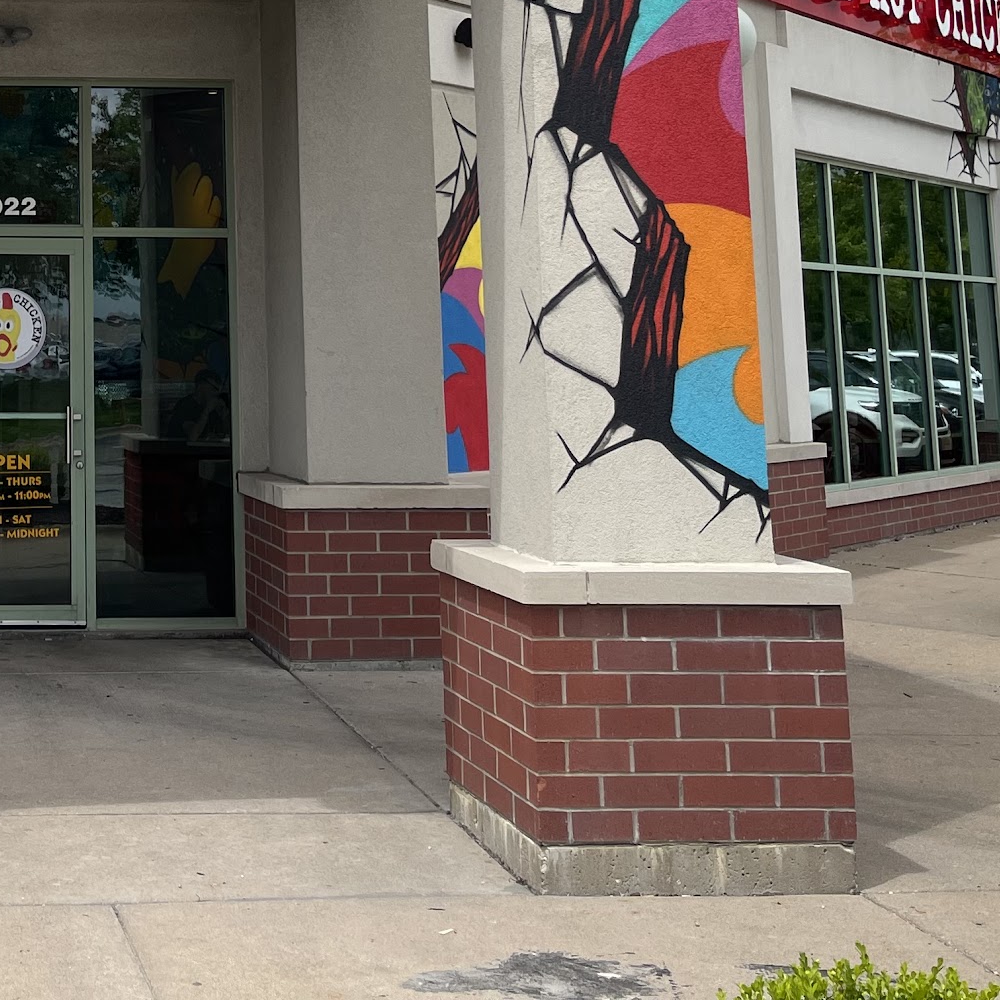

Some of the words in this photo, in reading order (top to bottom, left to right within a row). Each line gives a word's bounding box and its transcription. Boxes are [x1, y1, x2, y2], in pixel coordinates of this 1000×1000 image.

[14, 294, 42, 344] CHICKEN
[6, 476, 42, 486] THURS
[14, 490, 51, 500] 11:00PM
[12, 514, 32, 524] SAT
[6, 528, 60, 539] MIDNIGHT
